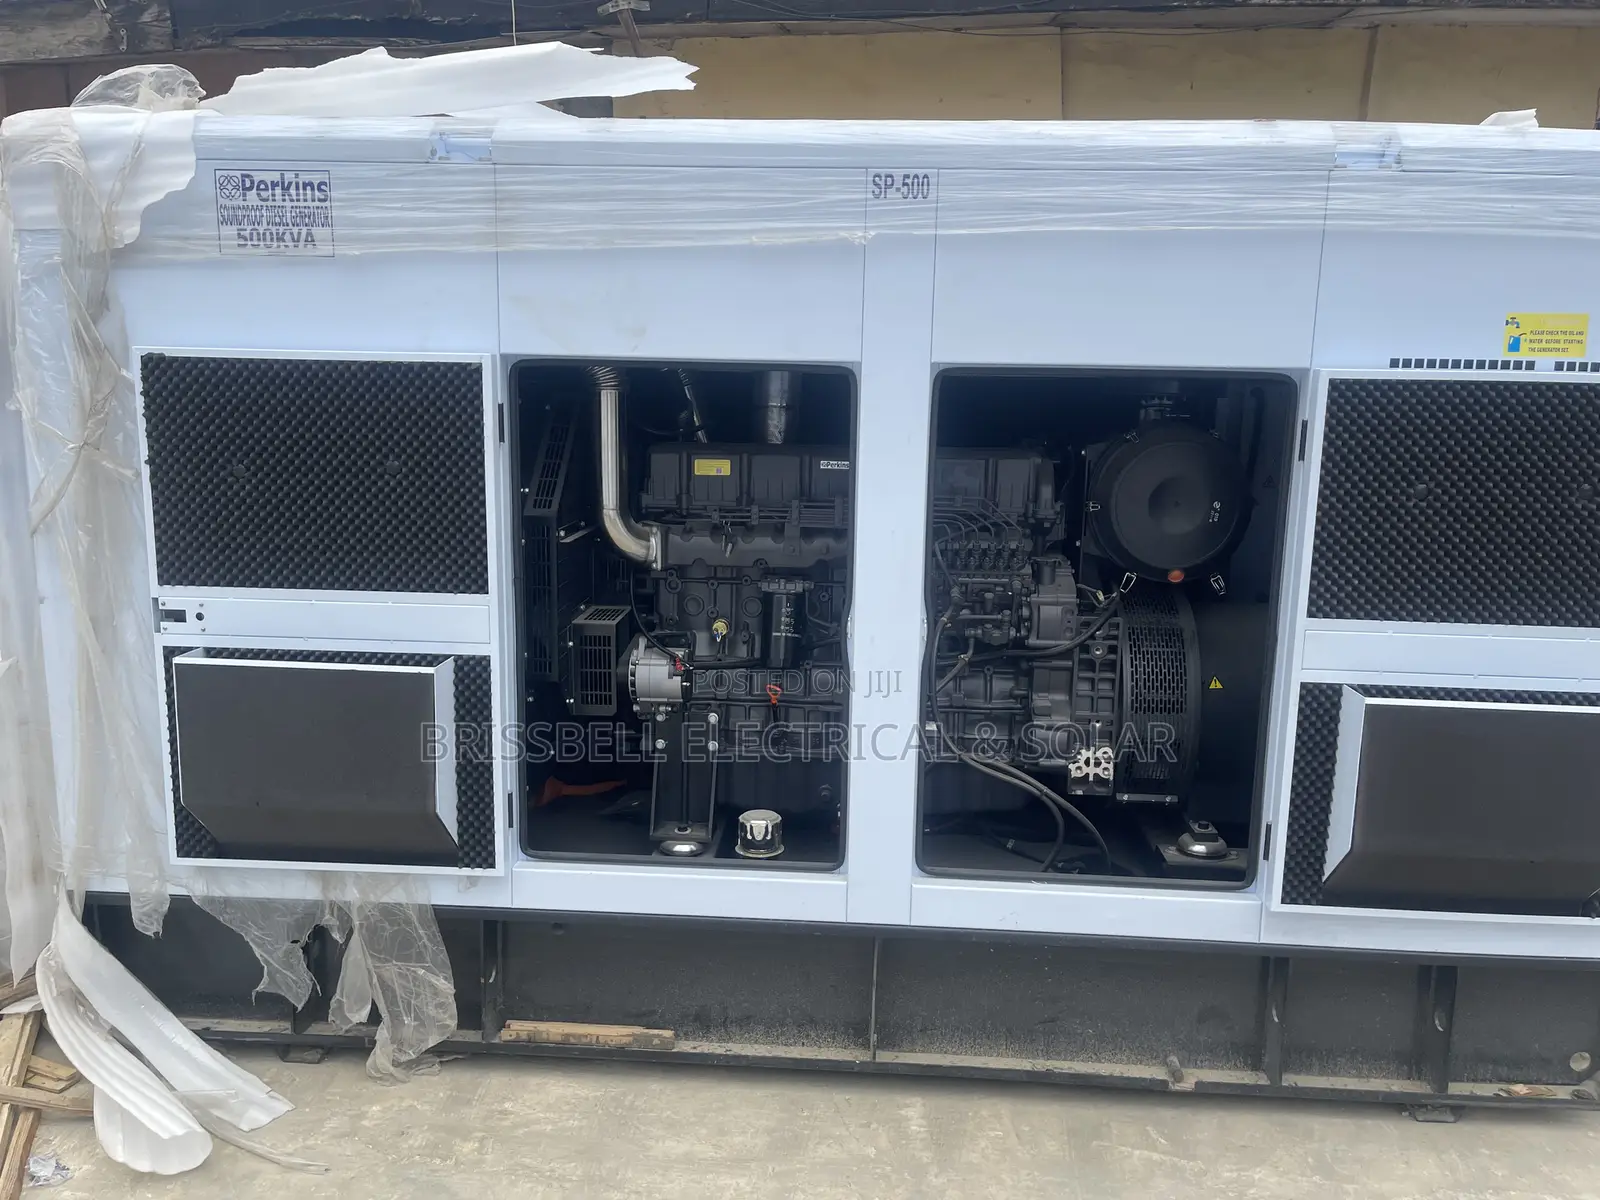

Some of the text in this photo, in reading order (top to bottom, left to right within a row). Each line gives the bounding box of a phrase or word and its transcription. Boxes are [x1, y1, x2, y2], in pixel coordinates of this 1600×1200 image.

[240, 172, 329, 203] Perkins
[871, 173, 930, 200] SP-500
[220, 203, 330, 228] SOUNDPROOF DIESEL GENERATOR
[236, 228, 317, 249] 500KVA
